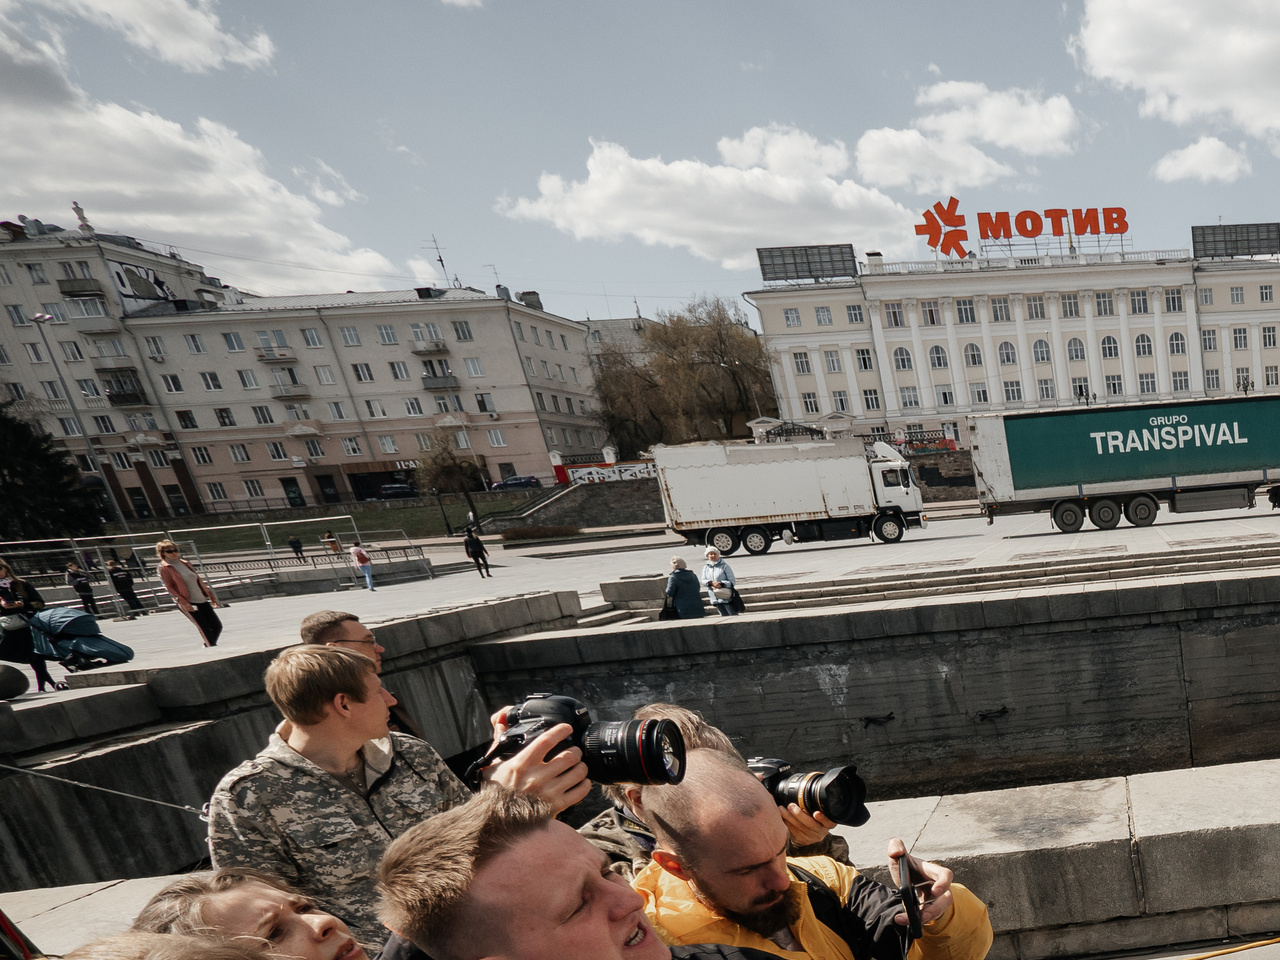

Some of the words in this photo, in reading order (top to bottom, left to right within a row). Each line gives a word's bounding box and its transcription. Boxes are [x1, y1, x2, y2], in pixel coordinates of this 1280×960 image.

[977, 207, 1128, 239] МОТИВ
[1149, 414, 1188, 426] GRUPO
[1089, 421, 1249, 455] TRANSPIVAL
